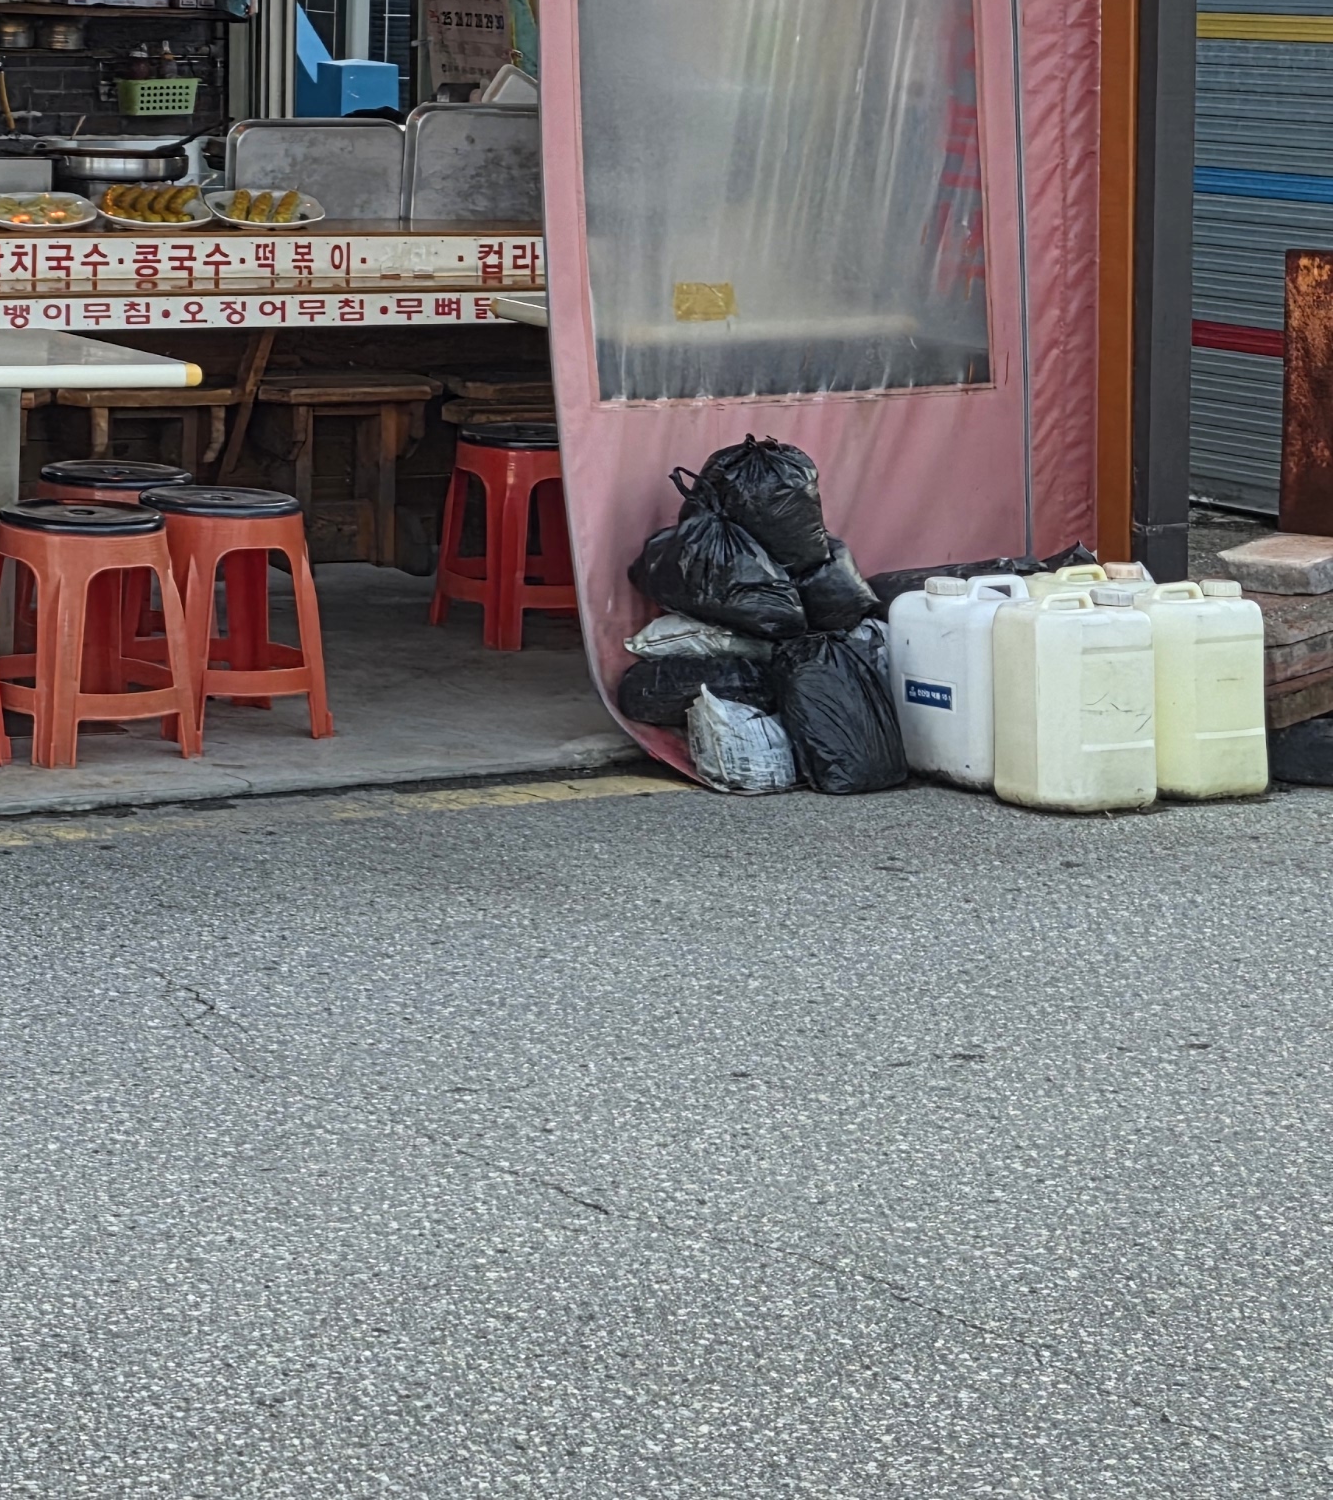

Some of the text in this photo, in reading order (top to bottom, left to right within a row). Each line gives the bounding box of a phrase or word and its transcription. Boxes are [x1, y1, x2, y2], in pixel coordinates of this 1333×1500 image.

[131, 242, 234, 278] 콩국수
[254, 241, 352, 277] 떡볶이
[179, 297, 366, 325] 오징어무침
